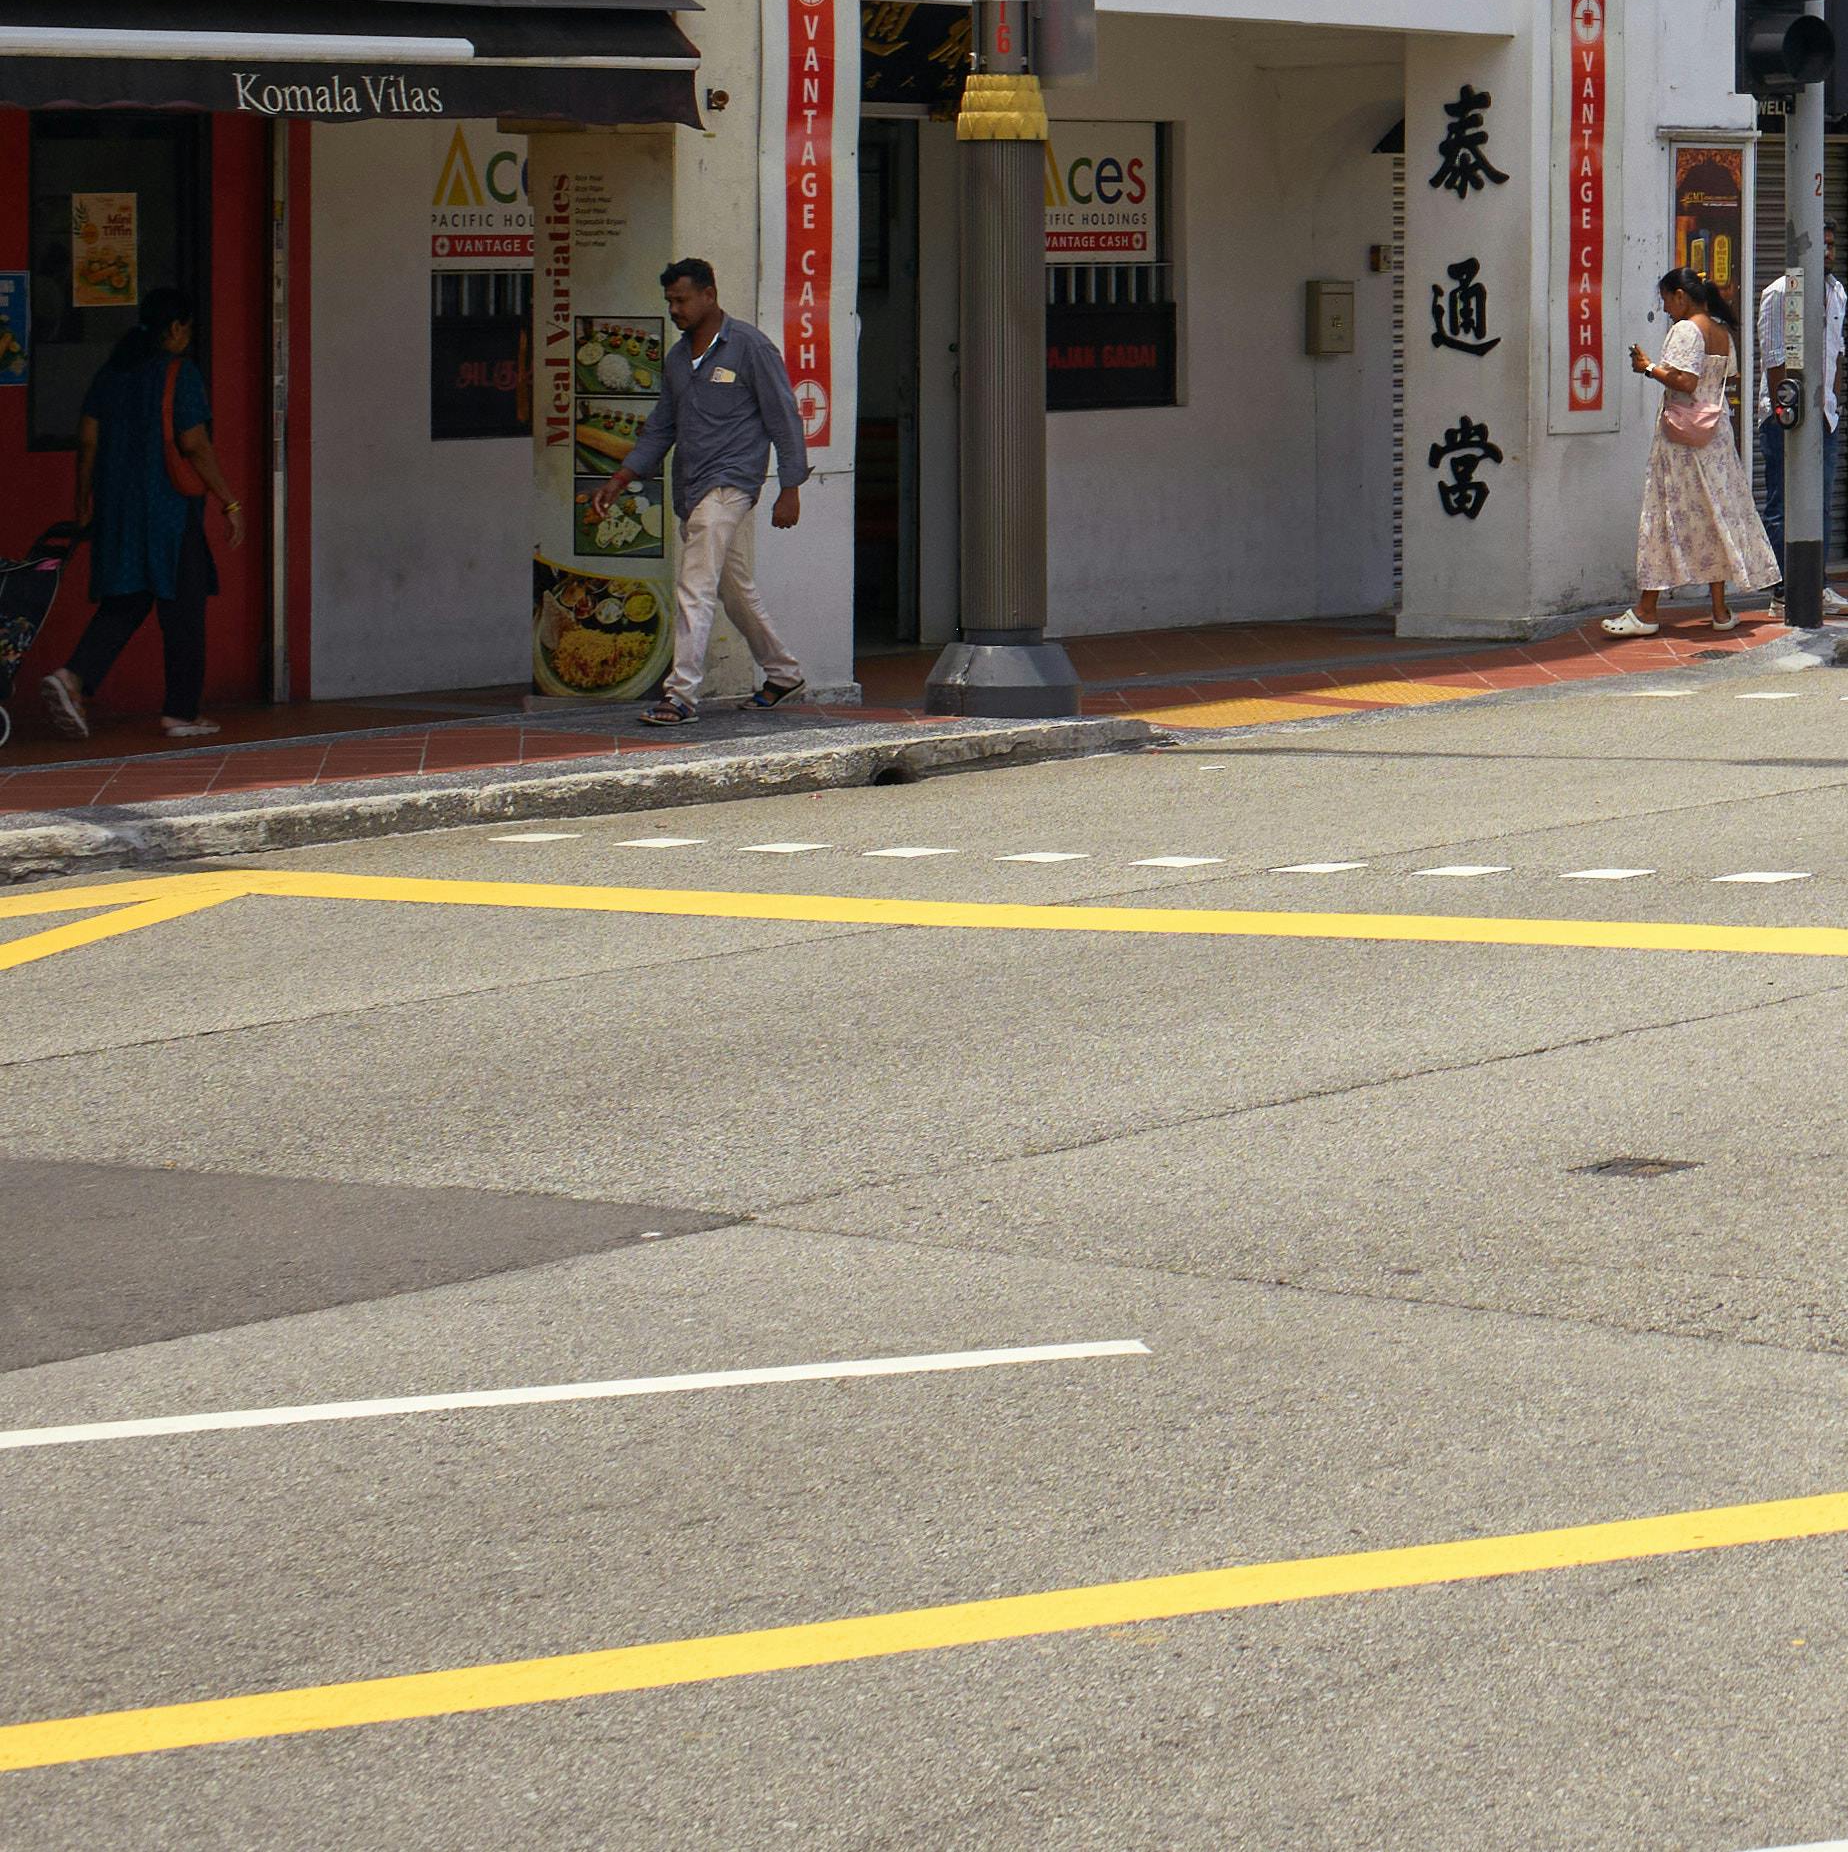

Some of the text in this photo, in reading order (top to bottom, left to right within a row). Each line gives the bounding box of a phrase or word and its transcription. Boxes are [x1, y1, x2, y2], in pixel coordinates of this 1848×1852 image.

[232, 71, 443, 115] Komala Vilas
[798, 14, 820, 370] VANTAGE CASH
[1579, 51, 1594, 347] VANTAGE CASH
[1081, 213, 1147, 226] HOLDINGS
[1100, 235, 1129, 248] CASH
[455, 238, 521, 253] VANTAGE
[545, 357, 570, 448] Meal
